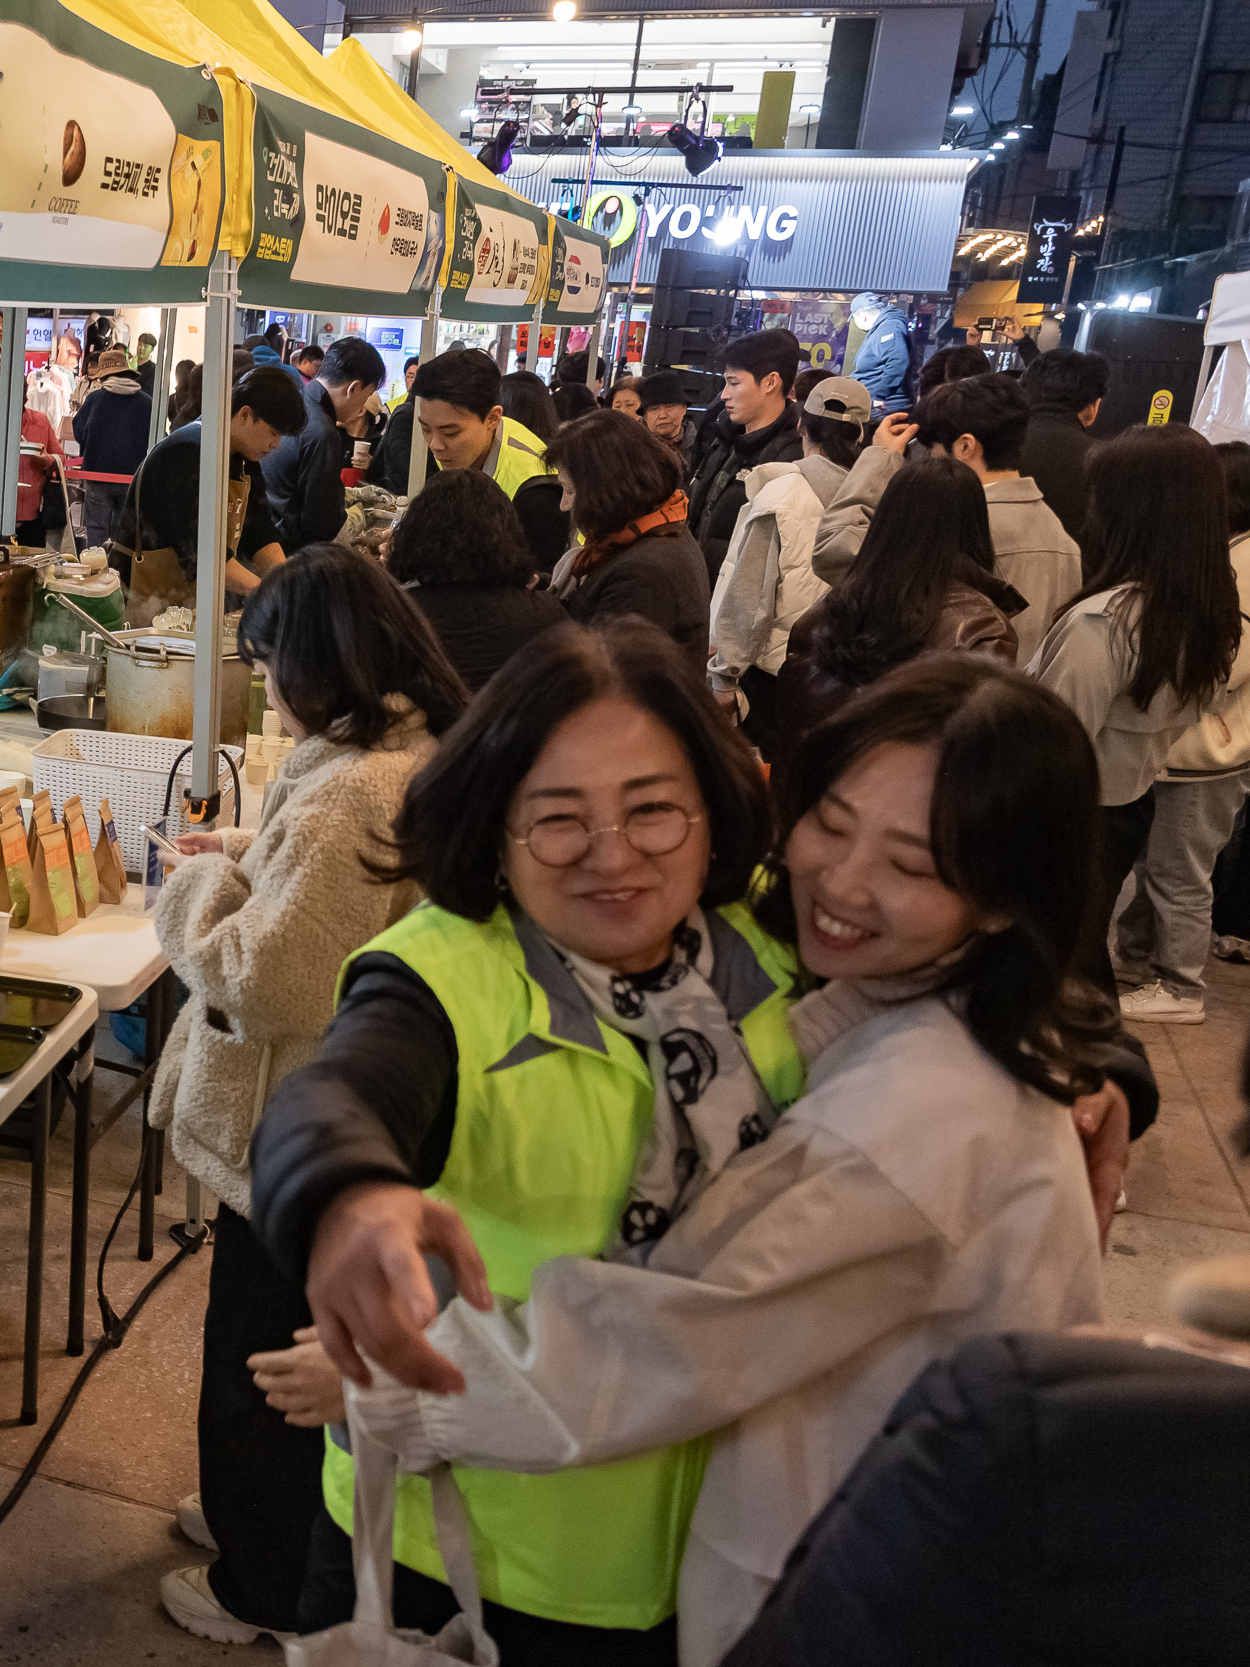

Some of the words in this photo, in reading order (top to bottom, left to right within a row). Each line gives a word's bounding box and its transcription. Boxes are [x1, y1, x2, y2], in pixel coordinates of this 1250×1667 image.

[142, 165, 161, 198] 원두
[48, 196, 80, 215] COFFEE
[316, 184, 363, 241] 막이오름
[256, 232, 293, 264] 팝업스토어
[1036, 227, 1058, 272] 우반장
[795, 312, 829, 324] LAST
